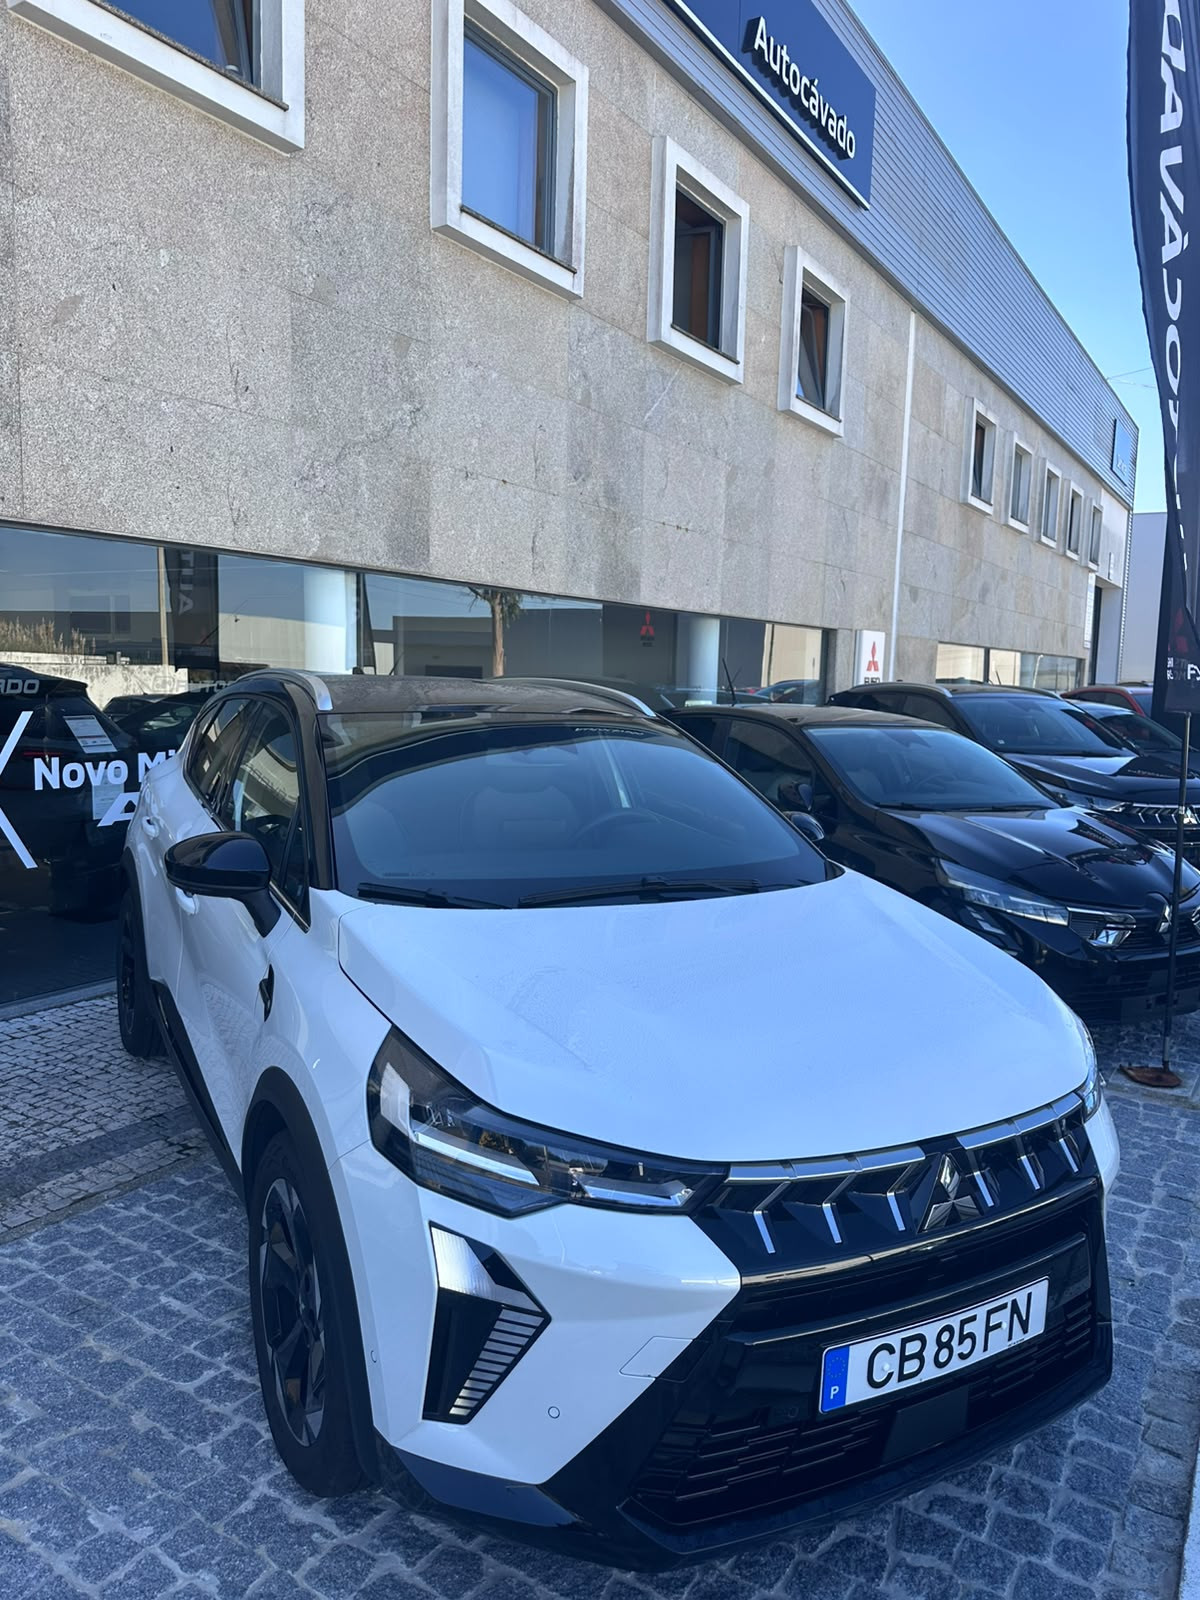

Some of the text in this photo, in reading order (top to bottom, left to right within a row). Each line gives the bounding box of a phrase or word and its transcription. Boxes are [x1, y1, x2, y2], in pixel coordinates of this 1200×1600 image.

[754, 16, 856, 159] Autocávado
[33, 749, 176, 790] Novo M
[830, 1385, 839, 1400] P
